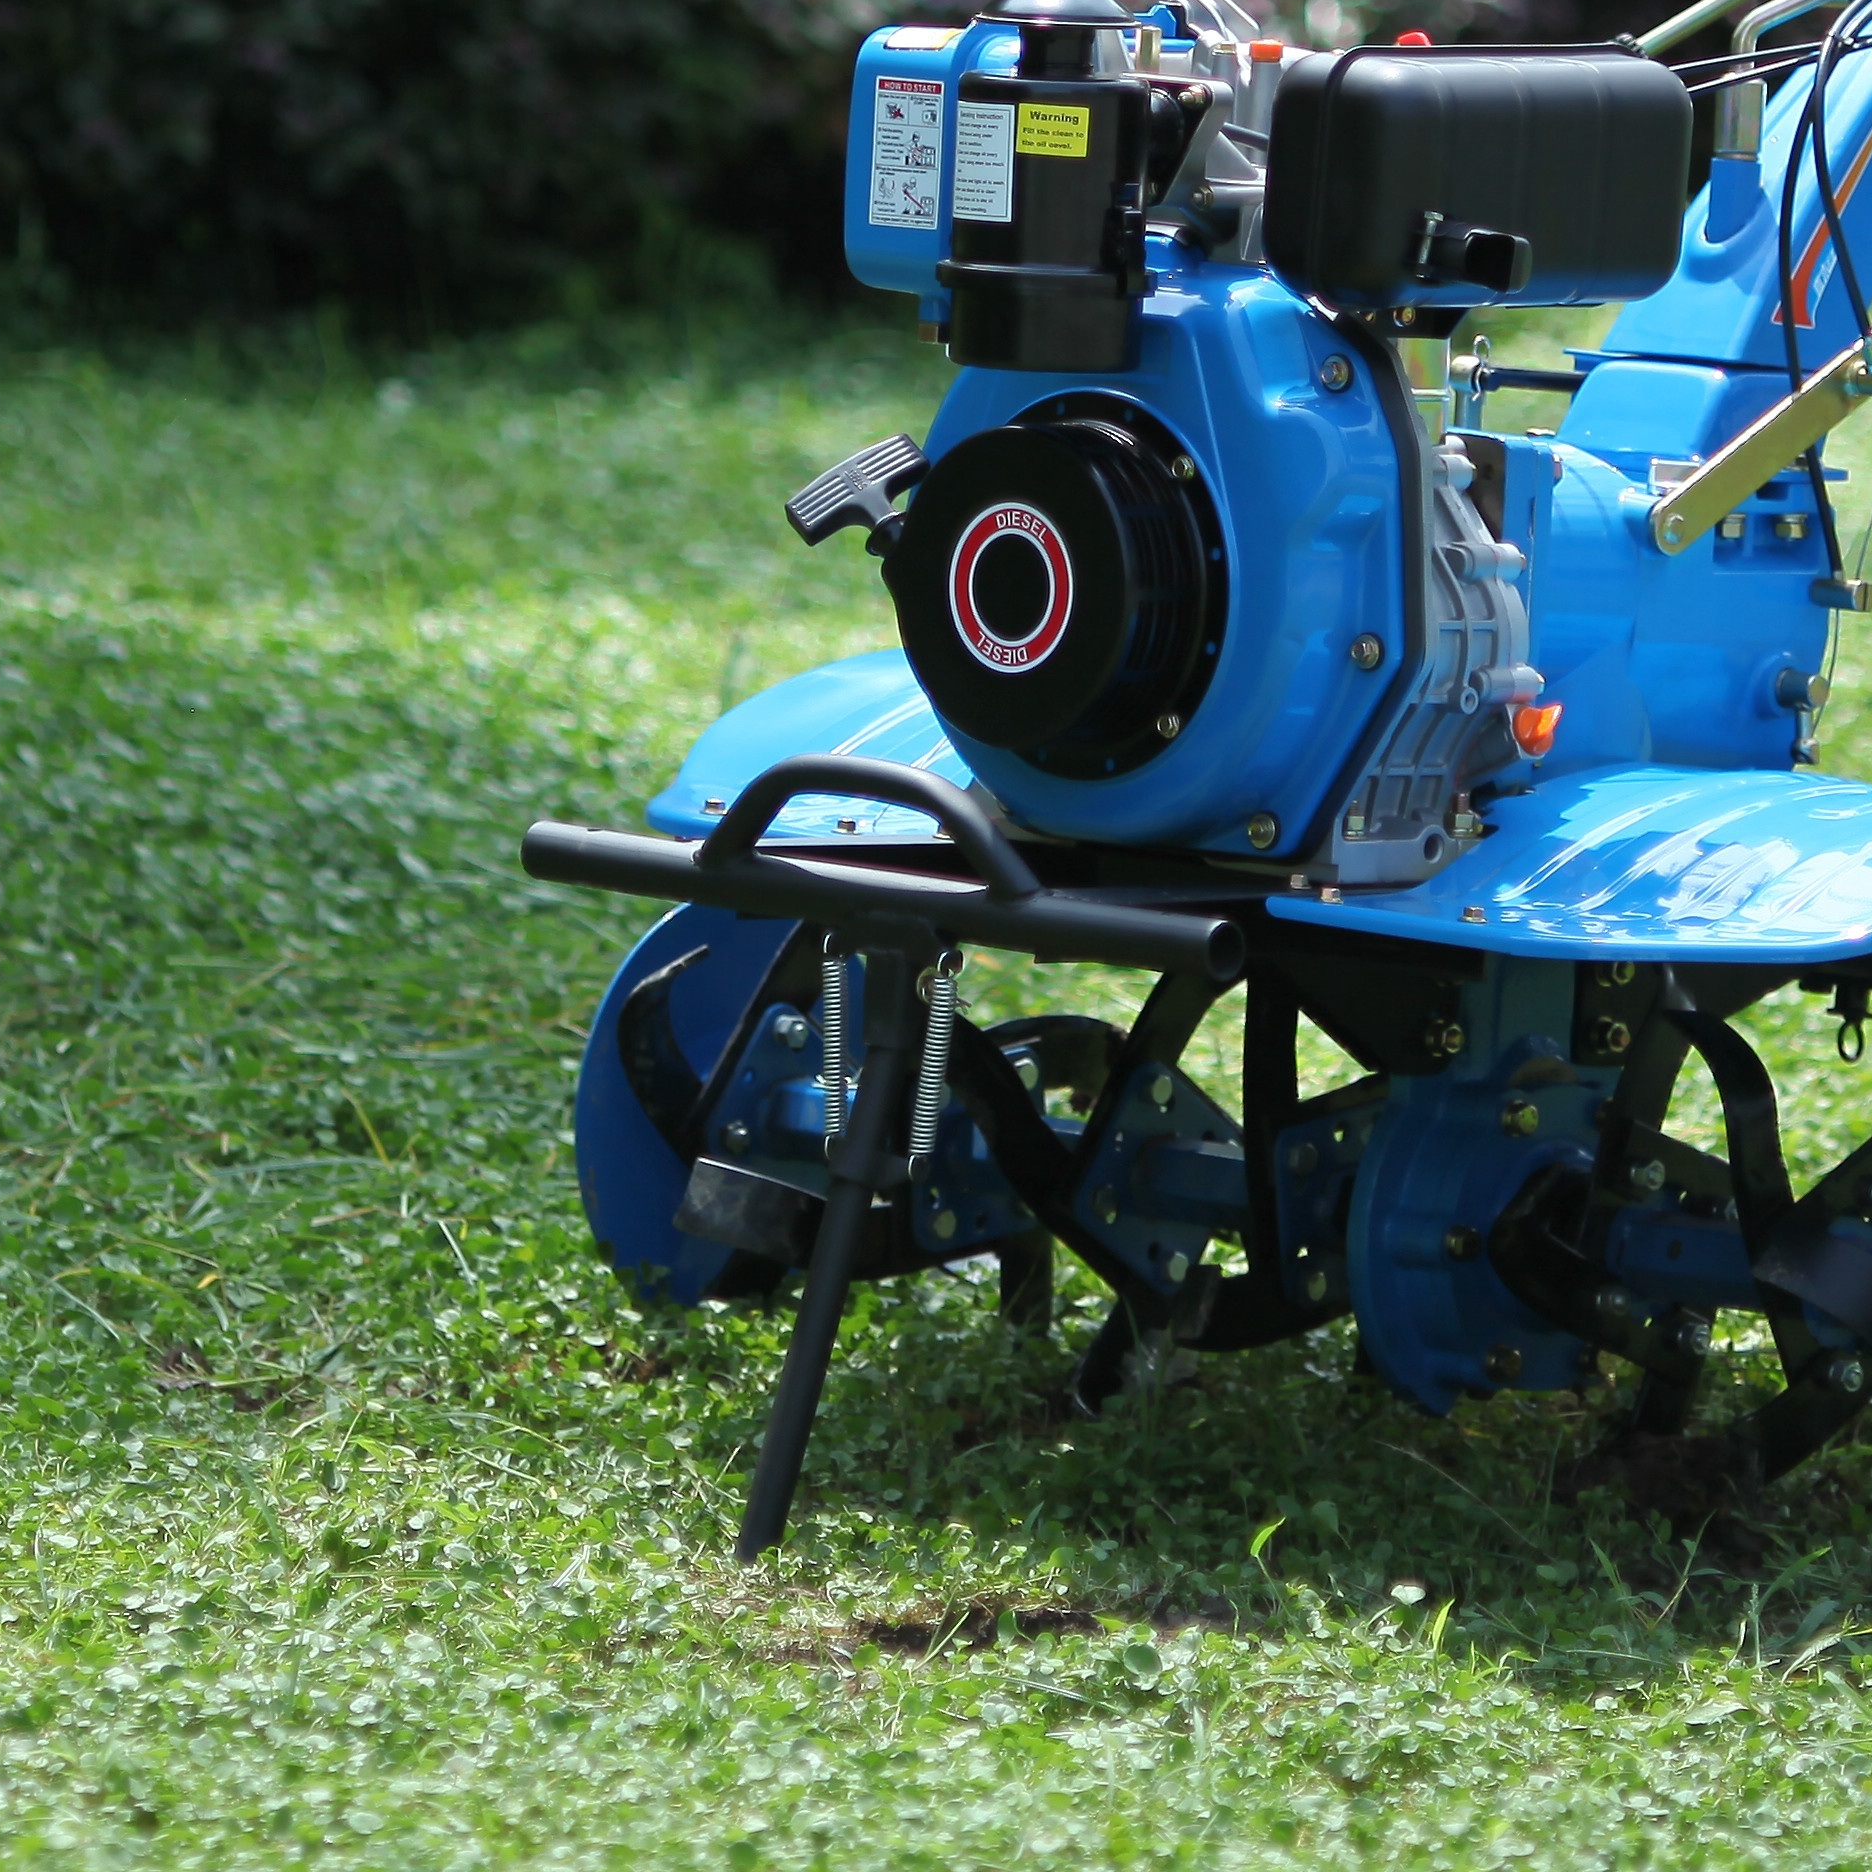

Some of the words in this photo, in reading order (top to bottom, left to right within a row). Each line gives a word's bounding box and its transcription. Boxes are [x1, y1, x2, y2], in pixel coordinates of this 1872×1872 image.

[884, 81, 901, 90] HOW
[903, 83, 913, 91] TO
[913, 83, 937, 93] START
[1030, 111, 1079, 126] Warning
[996, 511, 1047, 544] DIESEL
[977, 631, 1028, 664] DIESEL
